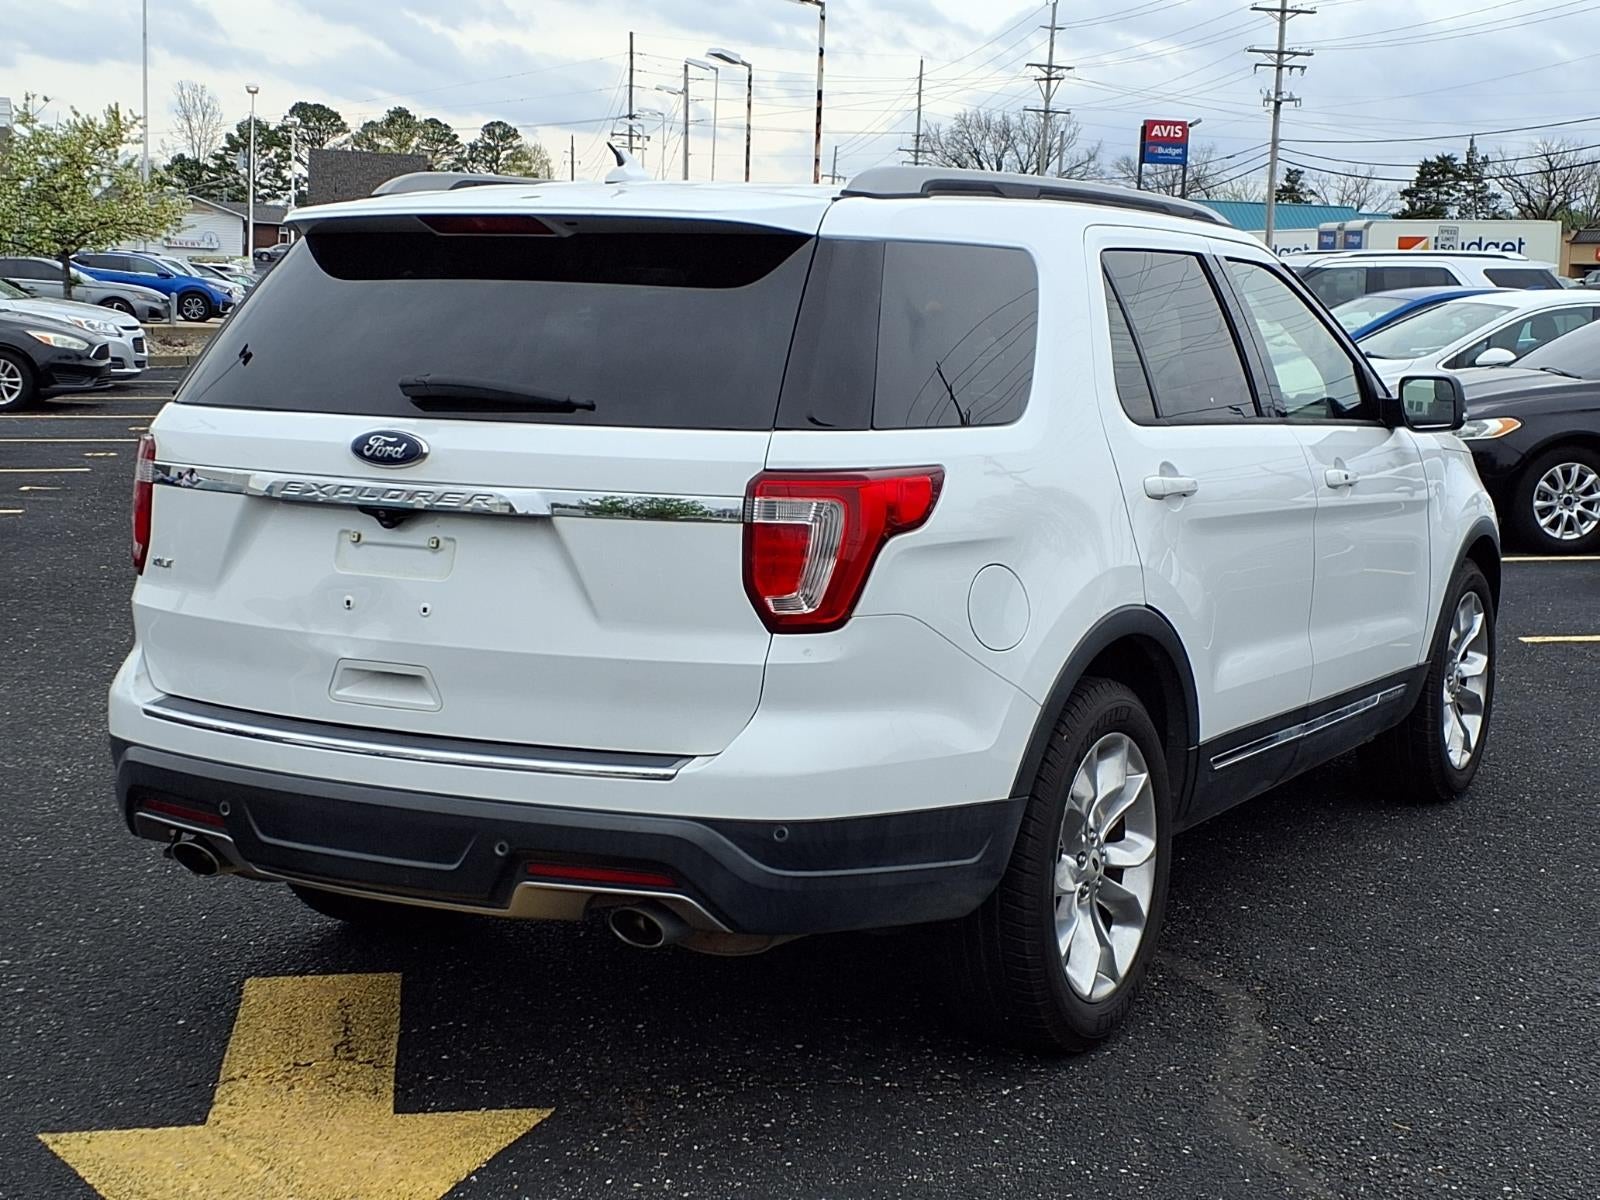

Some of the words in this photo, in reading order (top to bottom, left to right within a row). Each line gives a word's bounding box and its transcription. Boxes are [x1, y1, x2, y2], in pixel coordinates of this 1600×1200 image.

[1151, 125, 1183, 138] AVIS
[1158, 146, 1183, 156] Budget
[363, 433, 408, 460] Ford
[281, 480, 497, 508] EXPLORER
